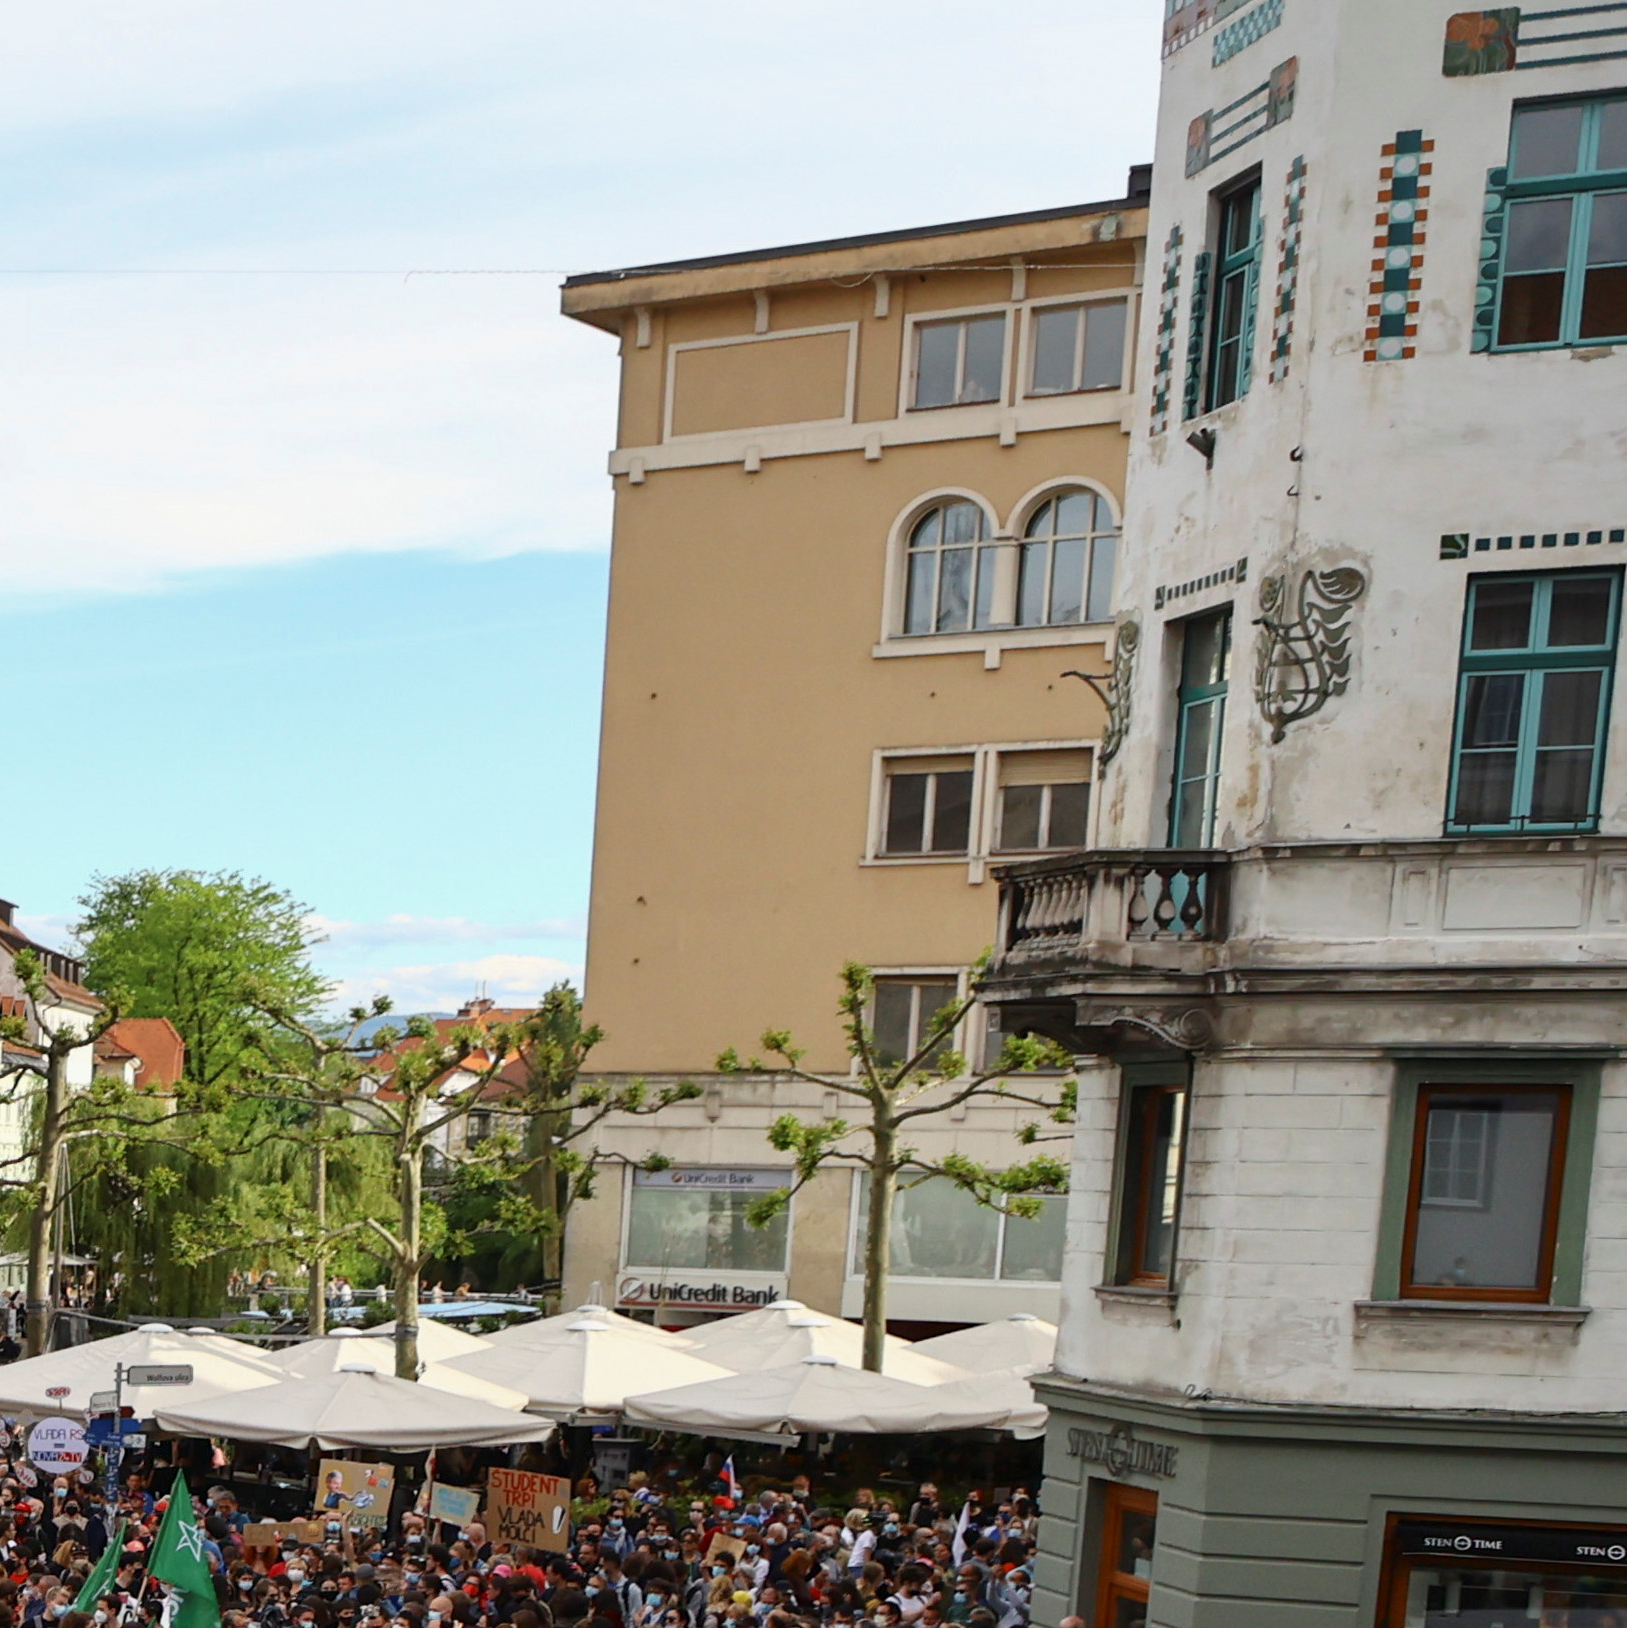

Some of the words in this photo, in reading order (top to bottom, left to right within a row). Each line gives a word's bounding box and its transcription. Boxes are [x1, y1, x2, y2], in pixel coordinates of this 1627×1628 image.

[683, 1173, 727, 1184] UniCredit
[729, 1173, 754, 1184] Bank
[649, 1281, 728, 1301] UniCredit
[732, 1285, 780, 1304] Bank
[34, 1429, 66, 1440] VLADA
[70, 1430, 84, 1441] RS
[491, 1470, 560, 1496] STUDENT
[503, 1489, 536, 1508] TRPI
[497, 1506, 546, 1529] VLADA
[1424, 1537, 1452, 1547] STEN
[1473, 1539, 1502, 1549] TIME
[1576, 1546, 1606, 1556] STEN
